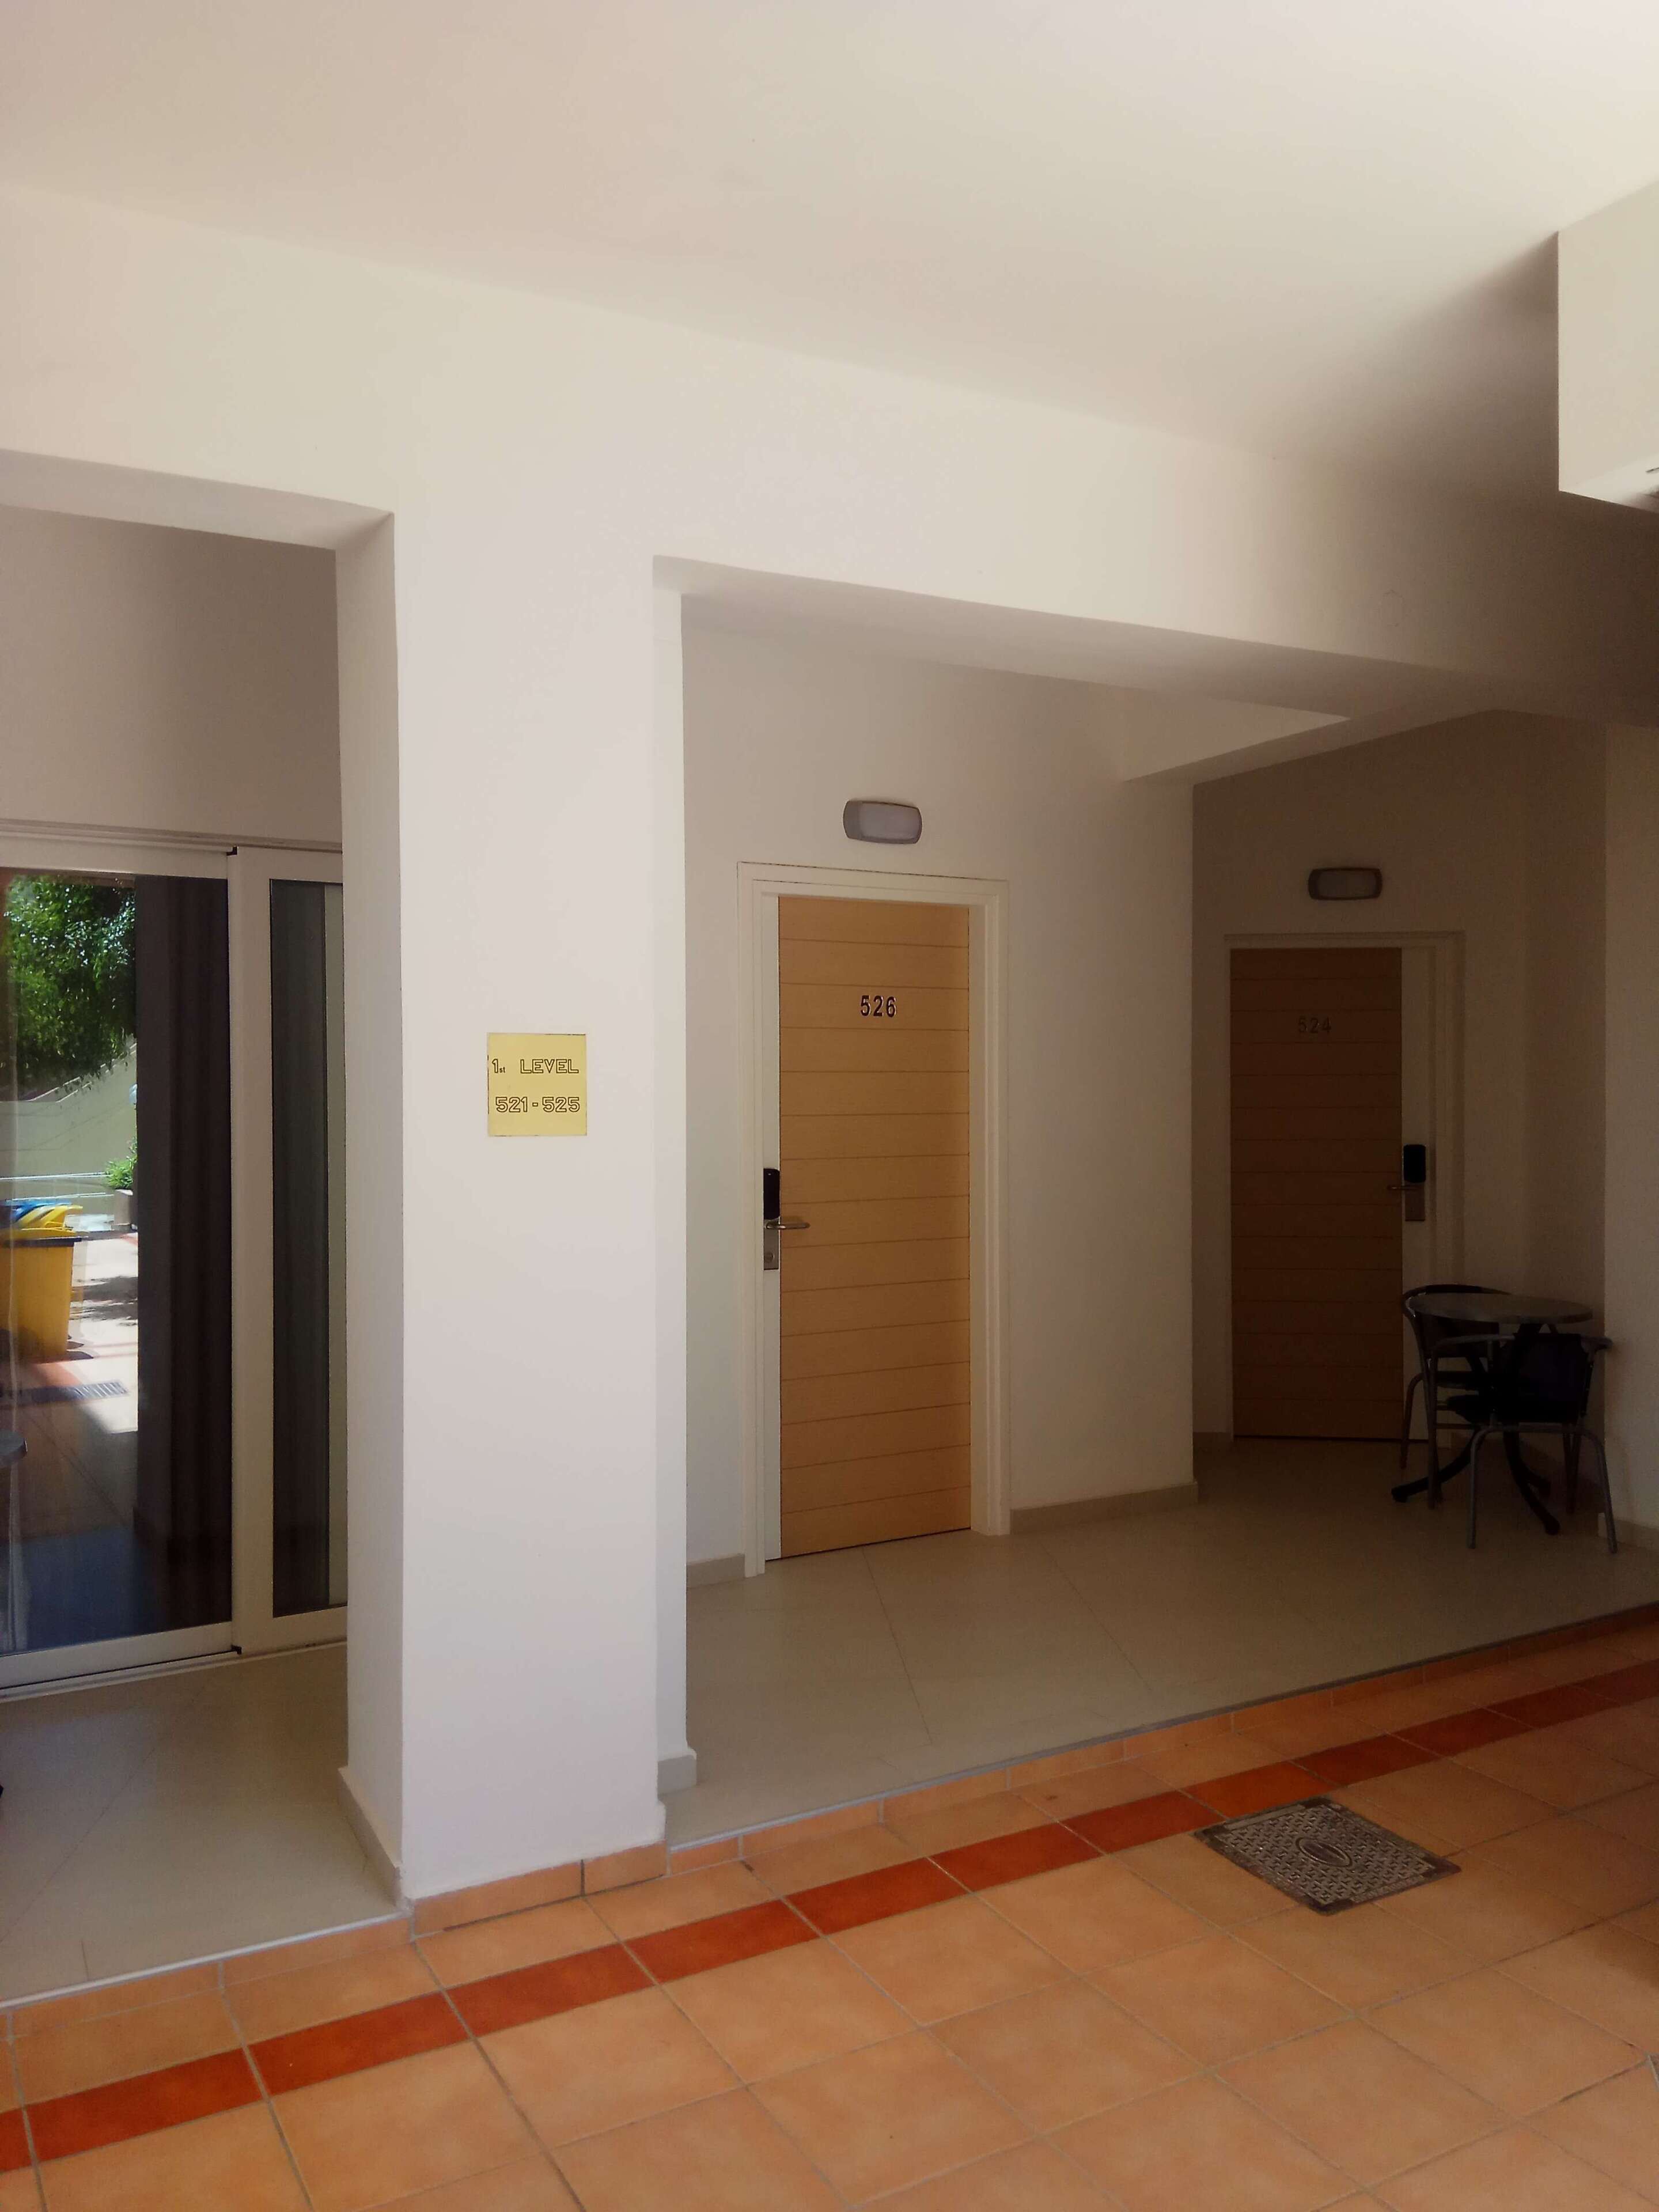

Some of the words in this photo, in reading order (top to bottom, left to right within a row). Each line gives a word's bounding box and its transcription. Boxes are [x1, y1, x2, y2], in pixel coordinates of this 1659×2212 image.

[861, 995, 896, 1018] 526
[1298, 1016, 1332, 1035] 524
[492, 1058, 506, 1074] 1st
[520, 1059, 579, 1074] LEVEL
